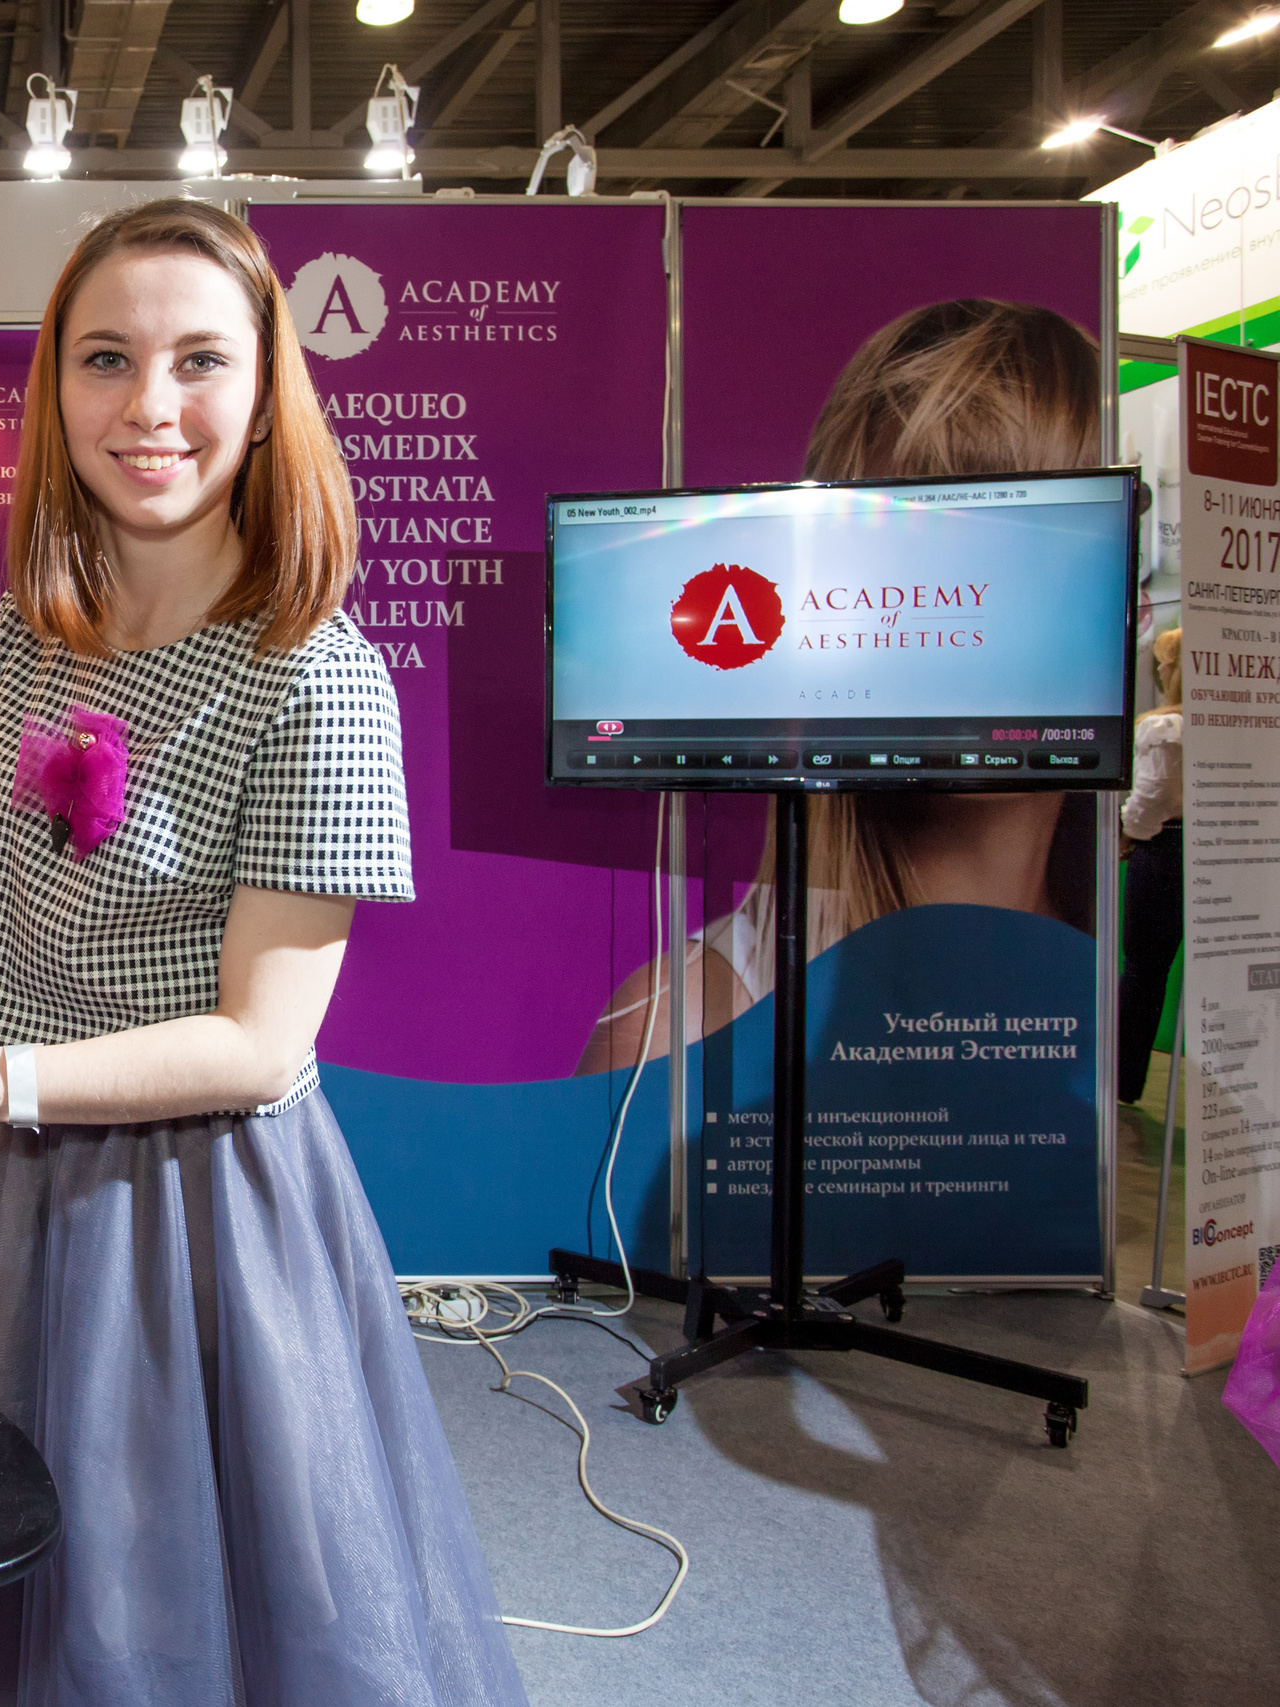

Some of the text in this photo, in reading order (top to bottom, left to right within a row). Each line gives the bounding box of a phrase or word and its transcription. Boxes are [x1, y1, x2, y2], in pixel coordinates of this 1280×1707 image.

[1163, 153, 1280, 250] Neos
[399, 280, 561, 303] ACADEMY
[470, 304, 488, 322] of
[398, 325, 558, 342] AESTHETICS
[1195, 370, 1270, 427] IECTC
[578, 507, 596, 518] New
[1220, 526, 1280, 573] 2017
[380, 558, 504, 586] YOUTH
[800, 583, 990, 611] ACADEMY
[880, 611, 902, 629] of
[798, 630, 984, 650] AESTHETICS
[1221, 627, 1262, 643] КРАСОТА
[1190, 650, 1280, 685] VII МЕЖ
[1191, 713, 1205, 727] ПО
[984, 754, 1018, 767] Скрыть
[1049, 754, 1080, 765] Выход
[883, 1012, 1078, 1036] Учебный центр
[829, 1040, 1078, 1064] Академия Эстетики
[817, 1108, 949, 1125] инъекционной
[730, 1137, 741, 1148] и
[868, 1133, 963, 1151] коррекции
[967, 1134, 1010, 1148] лица
[1014, 1133, 1026, 1145] и
[1030, 1132, 1066, 1145] тела
[821, 1158, 922, 1175] программы
[817, 1181, 905, 1198] семинары
[910, 1181, 921, 1193] и
[925, 1179, 1009, 1197] тренинги
